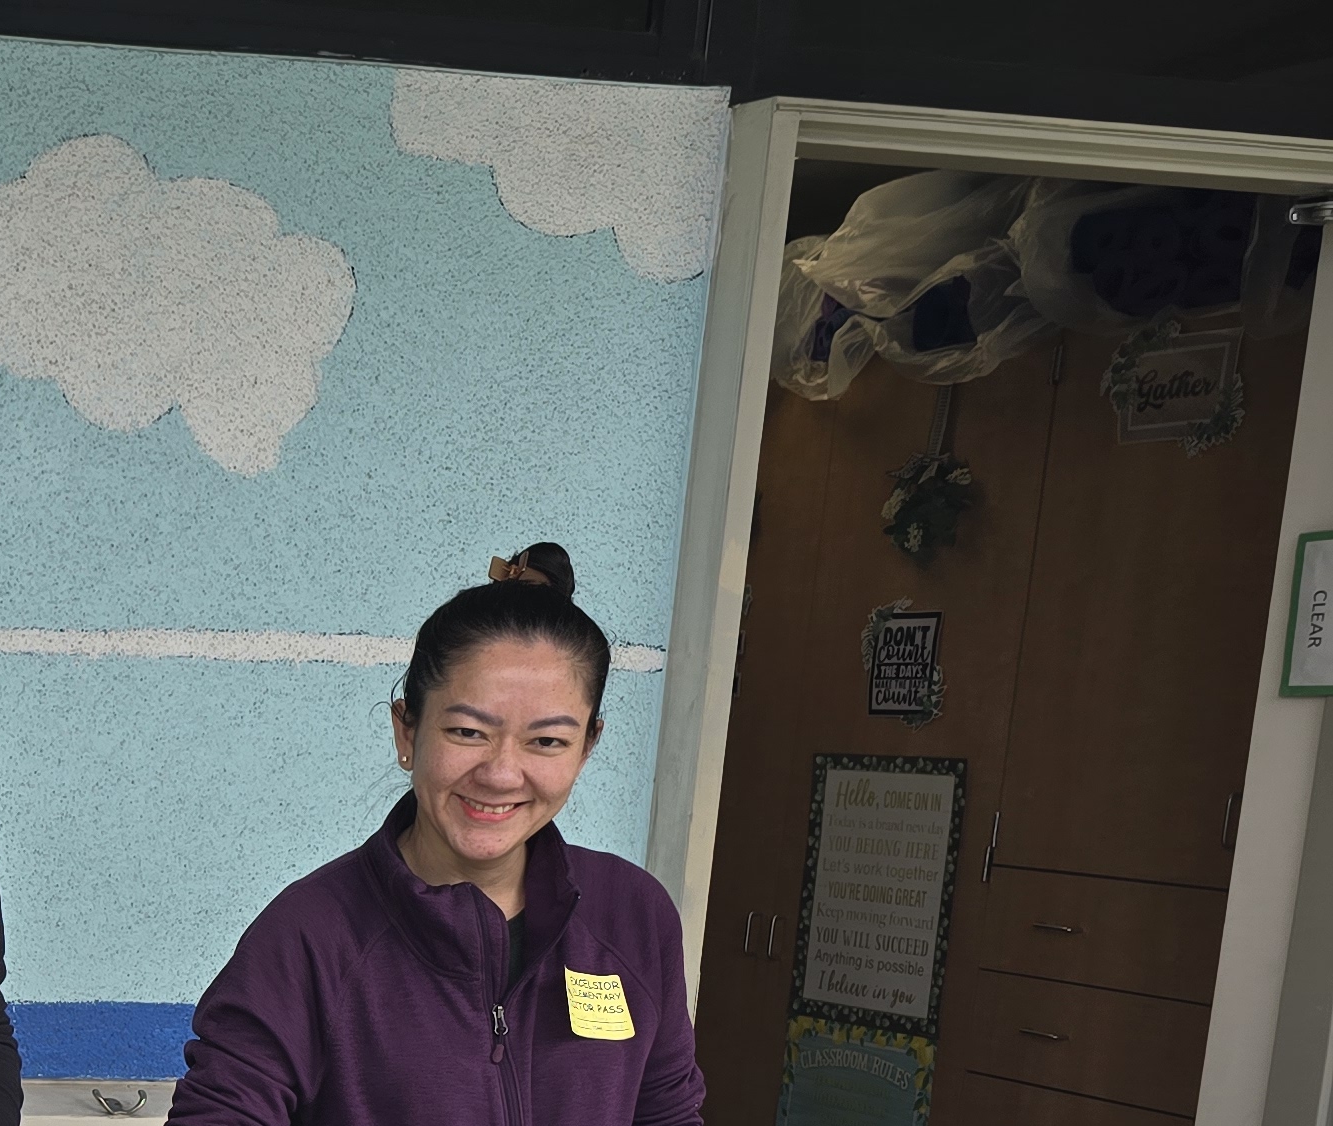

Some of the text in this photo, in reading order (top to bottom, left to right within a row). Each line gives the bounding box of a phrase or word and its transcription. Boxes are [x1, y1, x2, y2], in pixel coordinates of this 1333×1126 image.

[1136, 369, 1218, 413] Gather
[1307, 590, 1327, 648] CLEAR
[883, 626, 931, 646] DON'T
[878, 644, 931, 663] count
[880, 665, 897, 678] THE
[892, 680, 906, 689] THE
[835, 778, 943, 812] Hello, COME ON IN
[827, 813, 945, 838] Today is a brand new day
[828, 835, 941, 861] YOU BELONG HERE
[822, 857, 939, 883] Let's work together
[828, 880, 928, 908] YOU'RE DOING GREAT
[816, 902, 934, 931] Keep moving forward
[817, 926, 929, 957] YOU WILL SUCCEED
[814, 949, 925, 977] Anything is possible
[818, 970, 916, 1009] I believe in you
[800, 1048, 869, 1072] CLASSROOM
[870, 1055, 912, 1090] RULES
